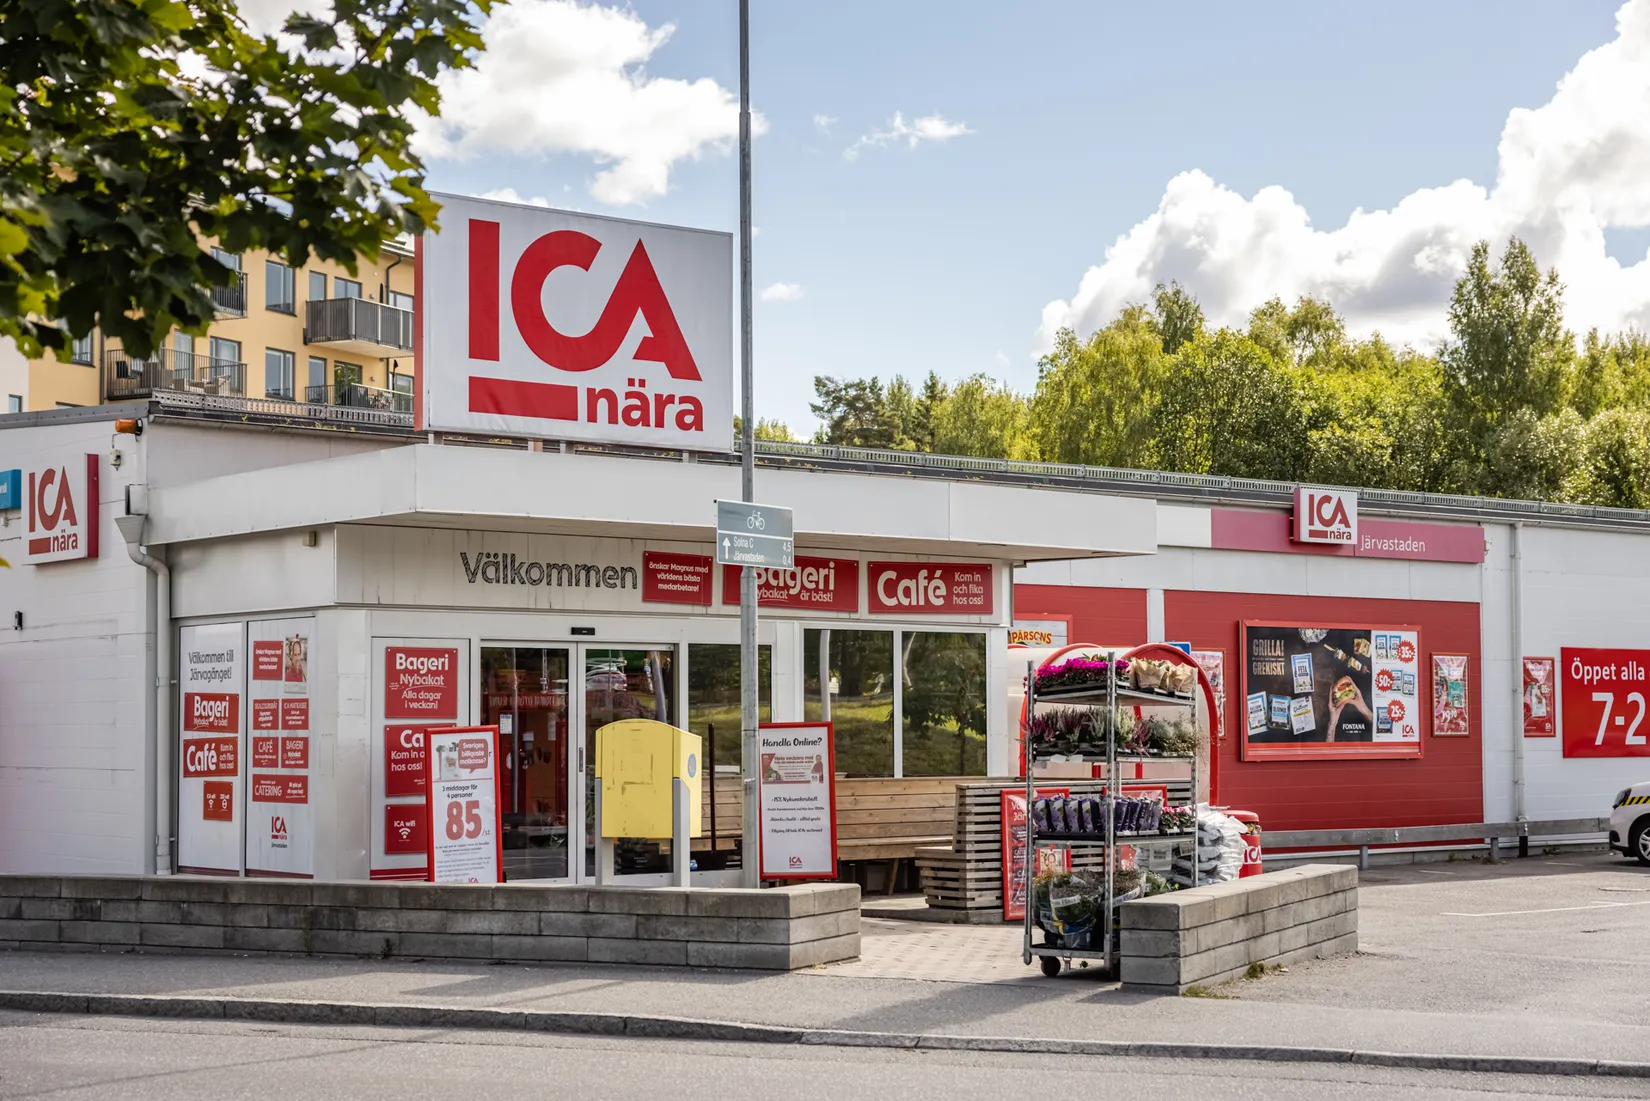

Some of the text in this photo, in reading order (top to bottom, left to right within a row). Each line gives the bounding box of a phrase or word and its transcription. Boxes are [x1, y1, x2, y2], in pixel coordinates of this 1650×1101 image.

[468, 218, 703, 372] ICA
[586, 377, 704, 431] nära
[28, 465, 78, 533] ICA
[1309, 494, 1351, 528] ICA
[52, 529, 78, 552] nära
[1329, 528, 1352, 540] nära
[733, 536, 754, 549] Solna C
[782, 542, 792, 553] 4,5
[1361, 535, 1426, 552] Järvastaden
[733, 551, 765, 562] Järvastaden
[782, 555, 792, 566] 0,4
[460, 552, 638, 589] Välkommen
[671, 564, 694, 572] Magnus
[954, 571, 982, 582] Kom in
[757, 587, 833, 602] ybakat är bäst!
[877, 569, 947, 606] Café
[953, 584, 984, 594] och fika
[953, 595, 984, 605] hos oss!
[188, 649, 234, 664] Välkommen till
[395, 653, 449, 674] Bageri
[1571, 657, 1617, 685] Öppet
[1621, 661, 1645, 681] alla
[400, 673, 444, 687] Nybakat
[401, 690, 442, 701] Alla dagar
[193, 695, 229, 722] Bageri
[409, 700, 438, 709] veckan!
[1402, 724, 1415, 734] ICA
[400, 729, 424, 748] Ca
[762, 737, 822, 747] Handla Online?
[186, 743, 217, 772] Café
[391, 750, 410, 760] Kom
[411, 749, 419, 759] in
[391, 762, 423, 771] hos oss!
[271, 816, 287, 833] ICA
[446, 800, 482, 840] 85
